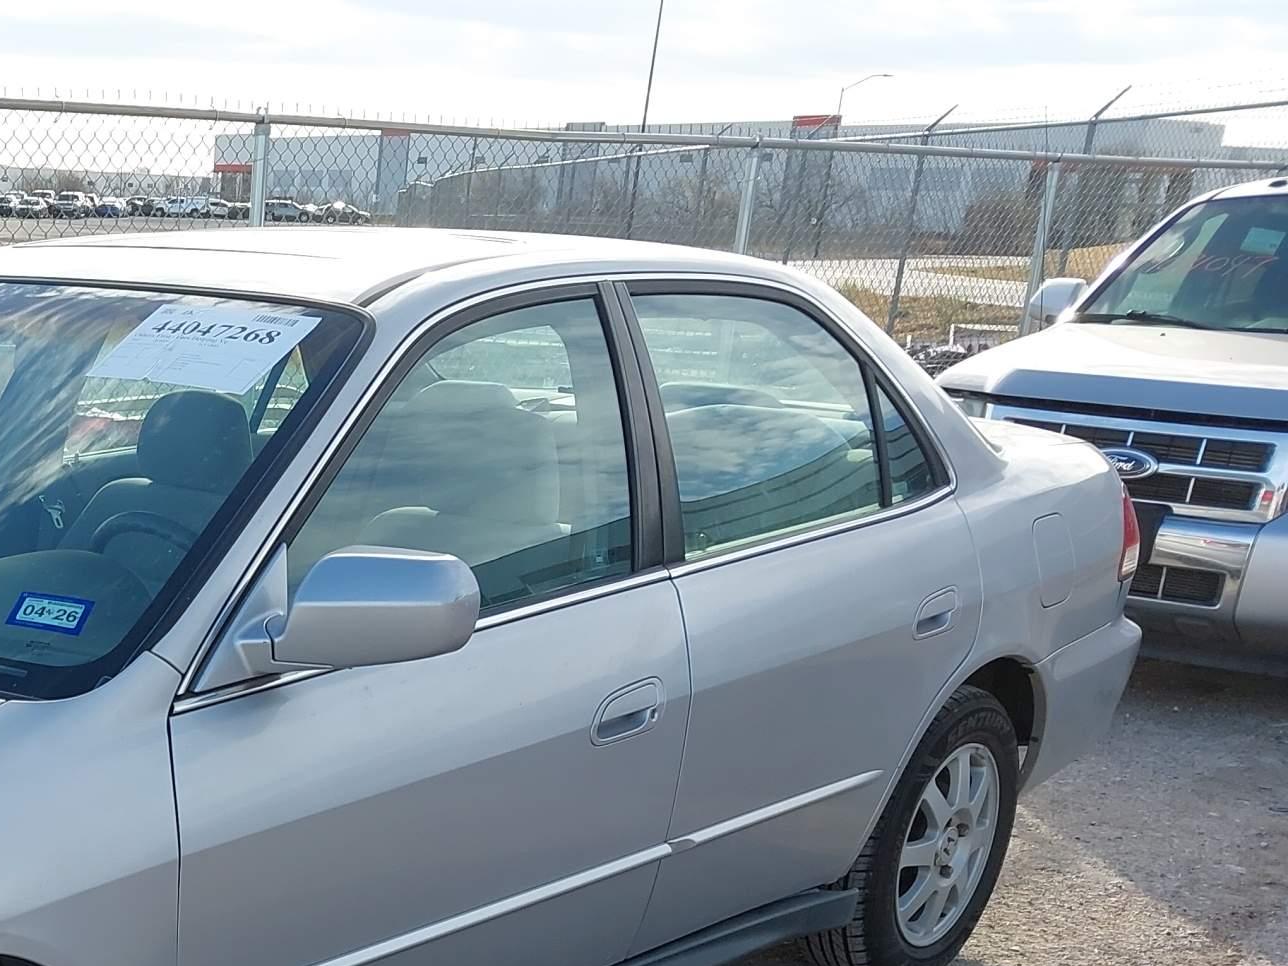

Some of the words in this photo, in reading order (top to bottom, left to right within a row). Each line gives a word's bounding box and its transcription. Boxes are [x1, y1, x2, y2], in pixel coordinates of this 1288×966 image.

[152, 320, 281, 345] 44047268
[22, 604, 46, 618] 04
[53, 608, 79, 623] 26
